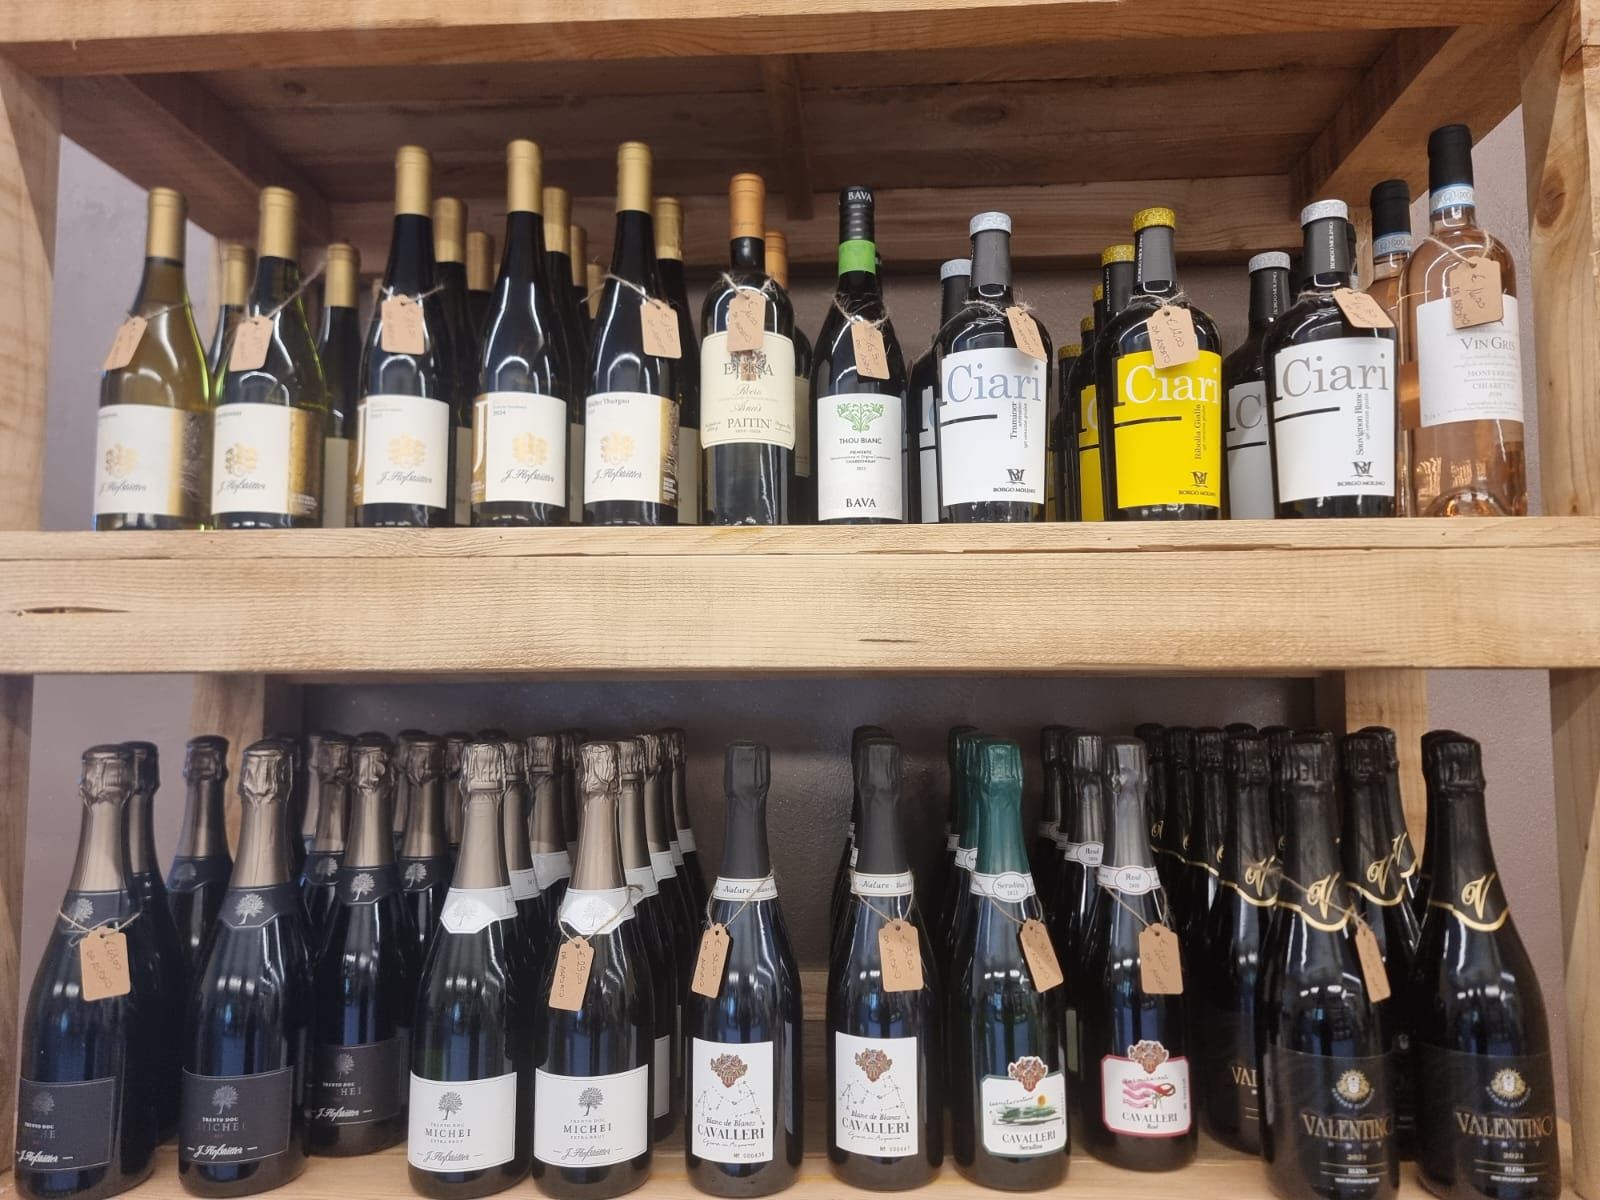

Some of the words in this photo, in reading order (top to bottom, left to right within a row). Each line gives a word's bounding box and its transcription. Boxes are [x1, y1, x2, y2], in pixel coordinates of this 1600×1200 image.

[848, 191, 872, 202] BAVA
[1282, 353, 1389, 398] Ciari
[947, 362, 1041, 403] Ciari
[839, 437, 858, 445] THOU
[861, 437, 883, 445] BIANC
[846, 497, 877, 508] BAVA
[723, 884, 750, 894] Nature
[861, 879, 889, 889] Nature
[869, 1112, 877, 1120] de
[1122, 1112, 1177, 1123] CAVALLERI
[563, 1123, 612, 1134] MICHEI
[842, 1117, 909, 1135] CAVALLERI
[425, 1128, 471, 1138] MICHEI
[697, 1124, 764, 1140] CAVALLERI
[1002, 1130, 1056, 1144] CAVALLERI
